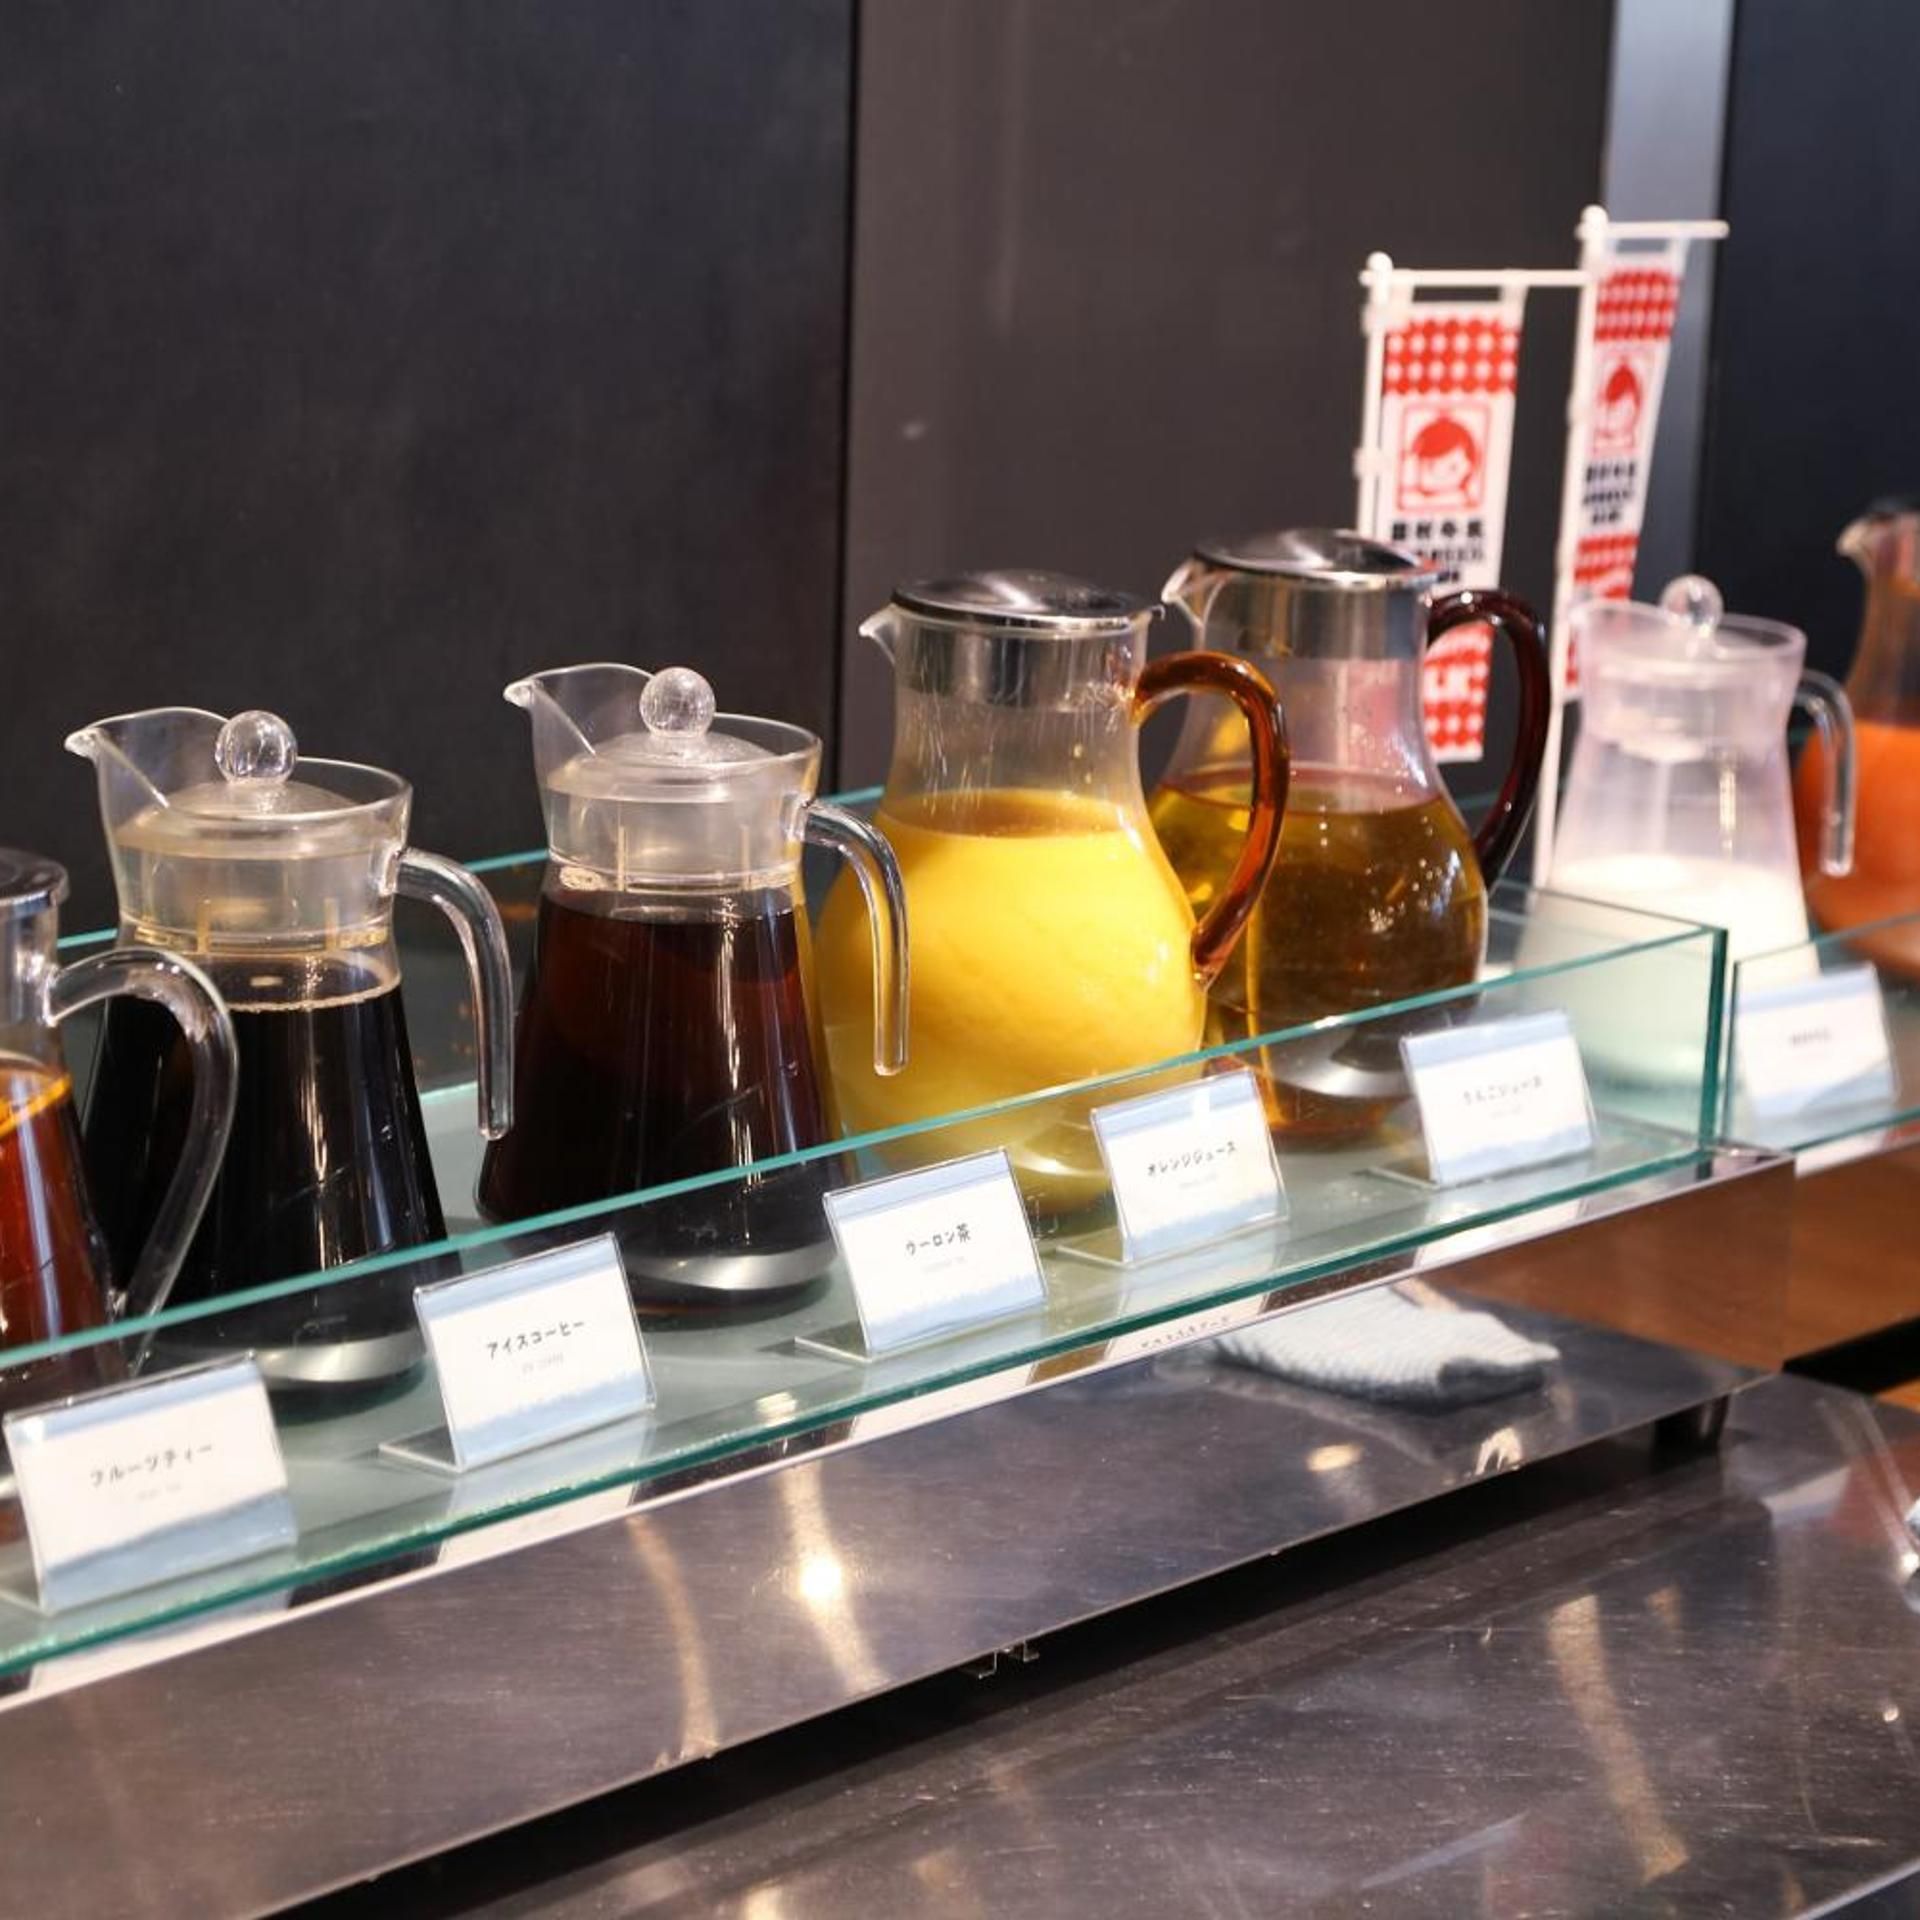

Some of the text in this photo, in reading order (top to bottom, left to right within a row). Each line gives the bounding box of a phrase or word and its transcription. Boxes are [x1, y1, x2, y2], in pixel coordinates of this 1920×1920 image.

[1147, 1141, 1236, 1176] オレンジジュース
[905, 1222, 971, 1256] ウーロン茶
[487, 1321, 584, 1360] アイスコーヒー
[90, 1444, 212, 1488] フルーツティー
